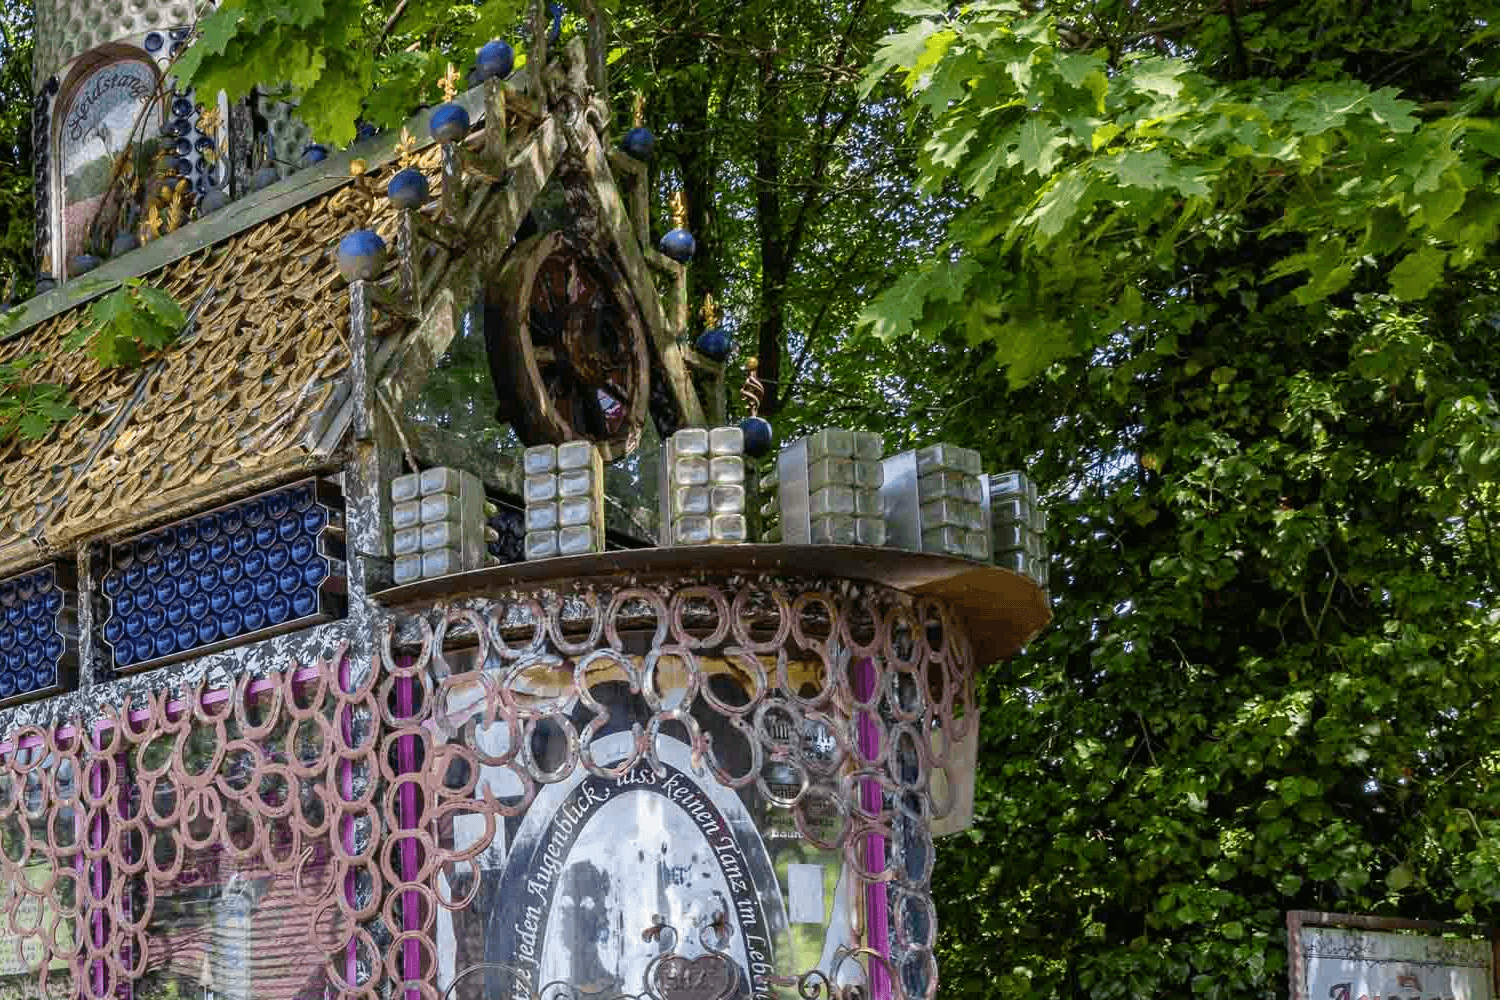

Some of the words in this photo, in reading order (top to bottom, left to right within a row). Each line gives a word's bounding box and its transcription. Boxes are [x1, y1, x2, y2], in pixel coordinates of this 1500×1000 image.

[662, 773, 721, 836] keinen
[715, 836, 748, 893] Tanz
[513, 906, 541, 968] jeden
[737, 901, 758, 926] im
[747, 935, 775, 999] Lebn
